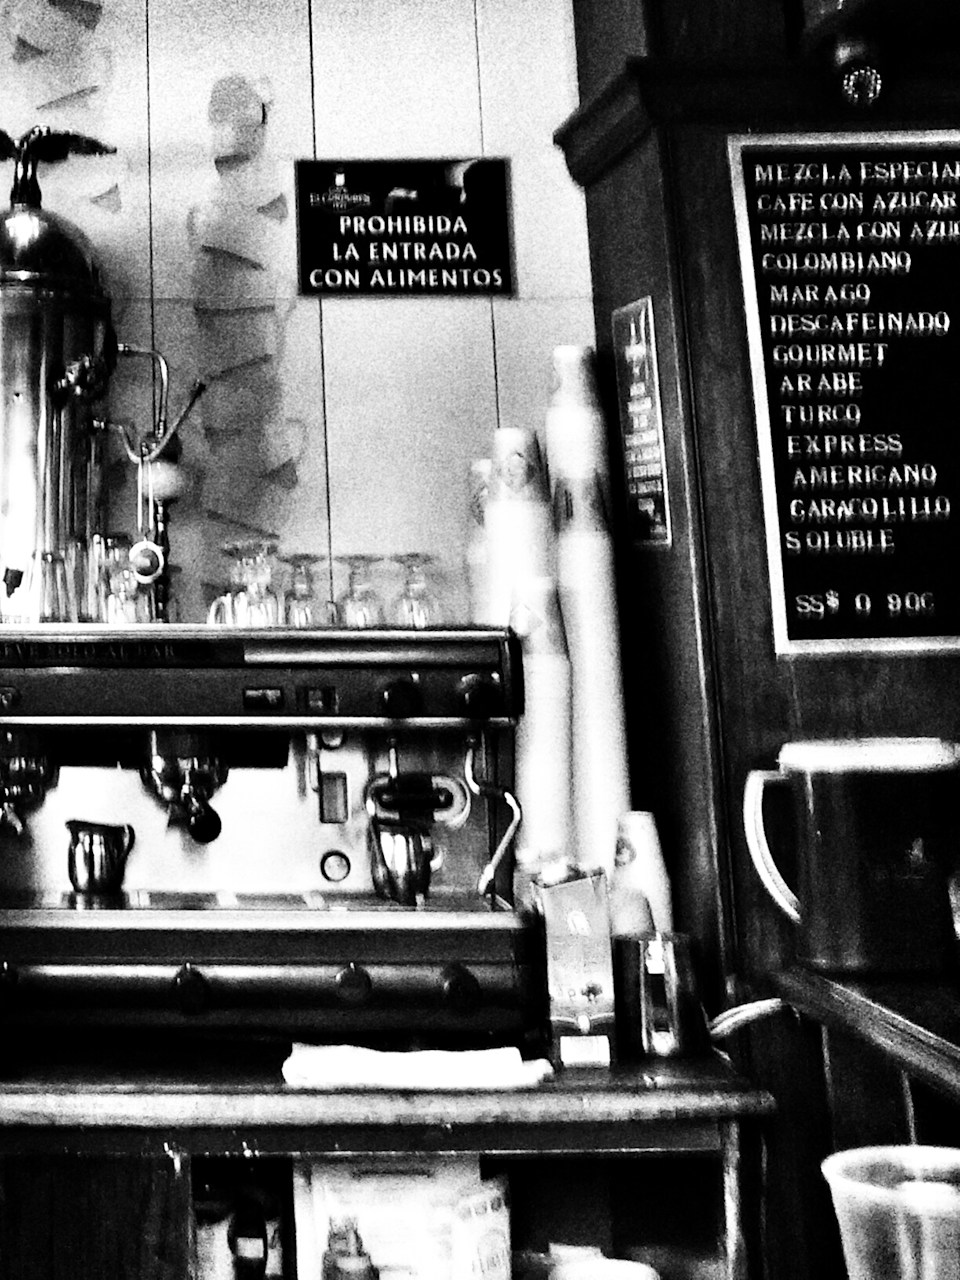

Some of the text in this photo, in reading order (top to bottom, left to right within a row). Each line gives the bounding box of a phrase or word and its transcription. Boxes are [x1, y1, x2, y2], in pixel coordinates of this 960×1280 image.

[756, 164, 851, 185] MEZCLA
[758, 191, 956, 214] CAFE CON AZUCAR
[340, 216, 467, 234] PROHIBIDA
[761, 223, 850, 242] MEZCLA
[857, 221, 900, 240] CON
[333, 242, 476, 261] LA ENTRADA
[763, 251, 911, 273] COLOMBIANO
[310, 269, 502, 288] CON ALIMENTOS
[771, 284, 870, 304] MARAGO
[771, 312, 950, 336] DESCAFEINADO
[773, 343, 888, 366] GOURMET
[781, 372, 862, 394] ARABE
[782, 405, 861, 424] TURCO
[788, 434, 902, 457] EXPRESS
[795, 464, 937, 486] AMERICANO
[785, 530, 894, 552] SOLUBLE
